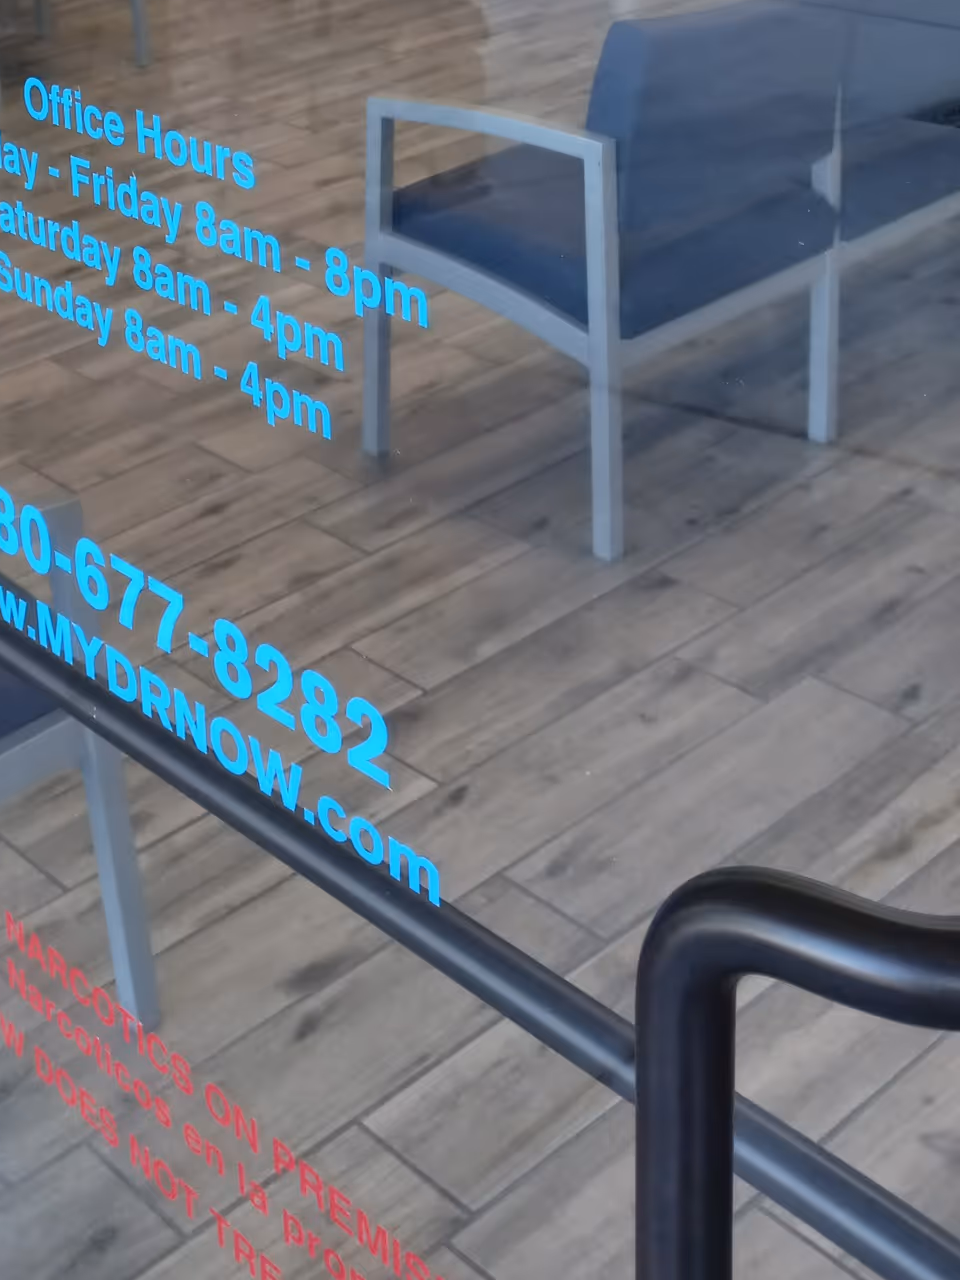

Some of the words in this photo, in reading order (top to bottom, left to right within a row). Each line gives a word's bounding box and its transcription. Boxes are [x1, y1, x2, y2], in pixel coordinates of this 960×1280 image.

[23, 77, 125, 147] Office
[136, 109, 256, 190] Hours
[70, 155, 183, 245] Friday
[195, 201, 282, 273] 8am
[324, 247, 429, 329] 8pm
[132, 245, 212, 316] 8am
[250, 295, 345, 372] 4pm
[124, 308, 202, 380] 8am
[240, 361, 332, 440] 4pm
[6, 910, 194, 1096] NARCOTICS
[205, 1082, 259, 1154] ON
[273, 1137, 446, 1280] PREMIS
[7, 957, 172, 1128] Narcoticos
[183, 1123, 225, 1177] en
[238, 1162, 269, 1216] la
[34, 1046, 119, 1148] DOES
[130, 1133, 199, 1219] NOT
